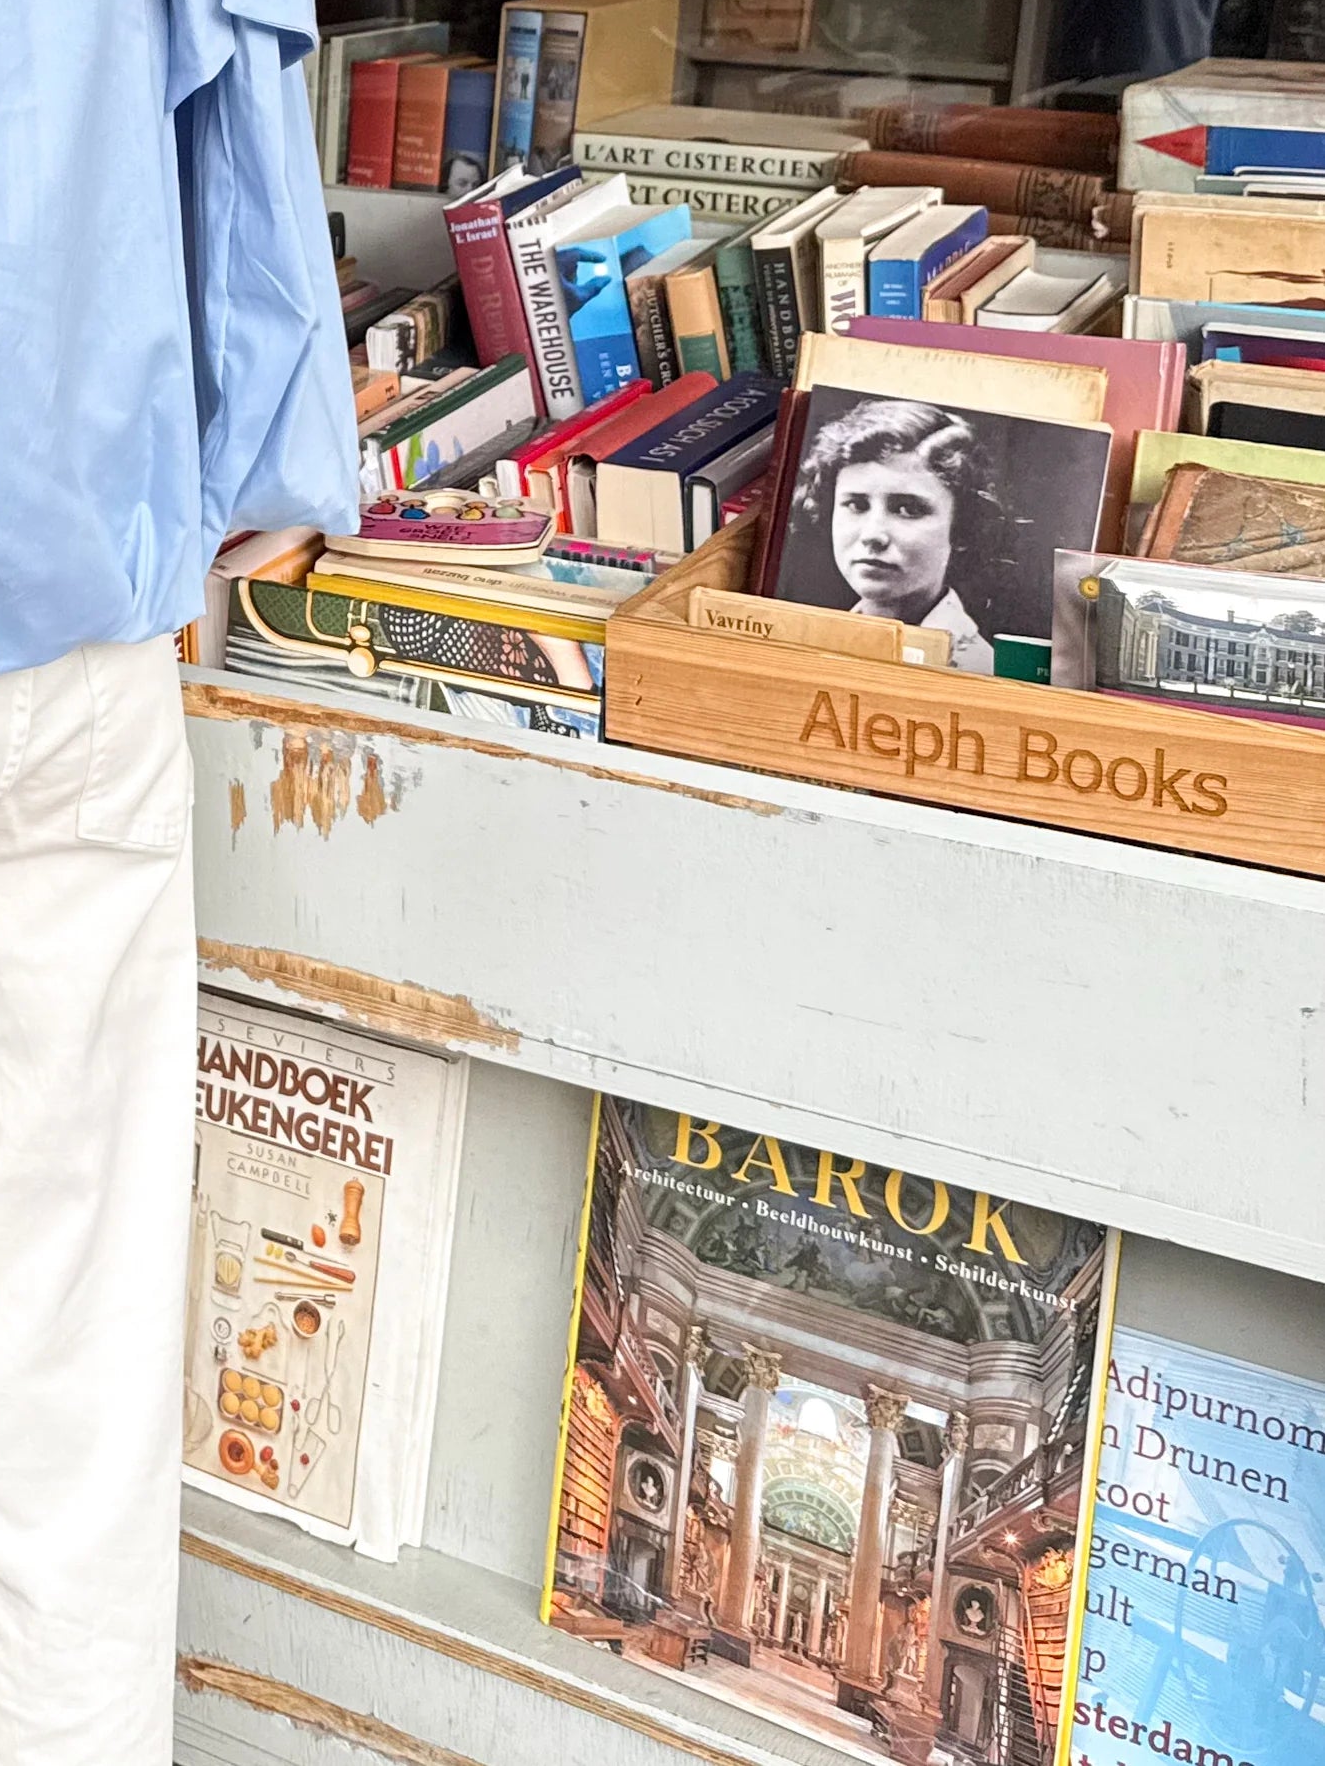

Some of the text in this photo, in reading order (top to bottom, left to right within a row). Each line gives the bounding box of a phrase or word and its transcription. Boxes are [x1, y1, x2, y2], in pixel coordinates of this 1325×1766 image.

[583, 143, 825, 180] L'ART CISTERCIEN
[449, 215, 500, 233] Jonathan
[466, 228, 498, 243] Israel
[518, 237, 547, 277] THE
[837, 279, 849, 287] OF
[528, 281, 575, 400] WAREHOUSE
[646, 288, 669, 366] BUTCHER'S
[423, 567, 471, 582] buzzati
[798, 687, 1231, 820] Aleph Books
[245, 1141, 298, 1169] SUSAN
[667, 1112, 1030, 1268] BAROK
[617, 1158, 1078, 1314] Architectuur Beeldhouwkunst Schilderkunst
[1132, 1422, 1290, 1504] Drunen
[1088, 1534, 1239, 1605] german
[1085, 1586, 1134, 1627] ult
[1084, 1645, 1107, 1682] p
[1073, 1698, 1255, 1766] sterdam
